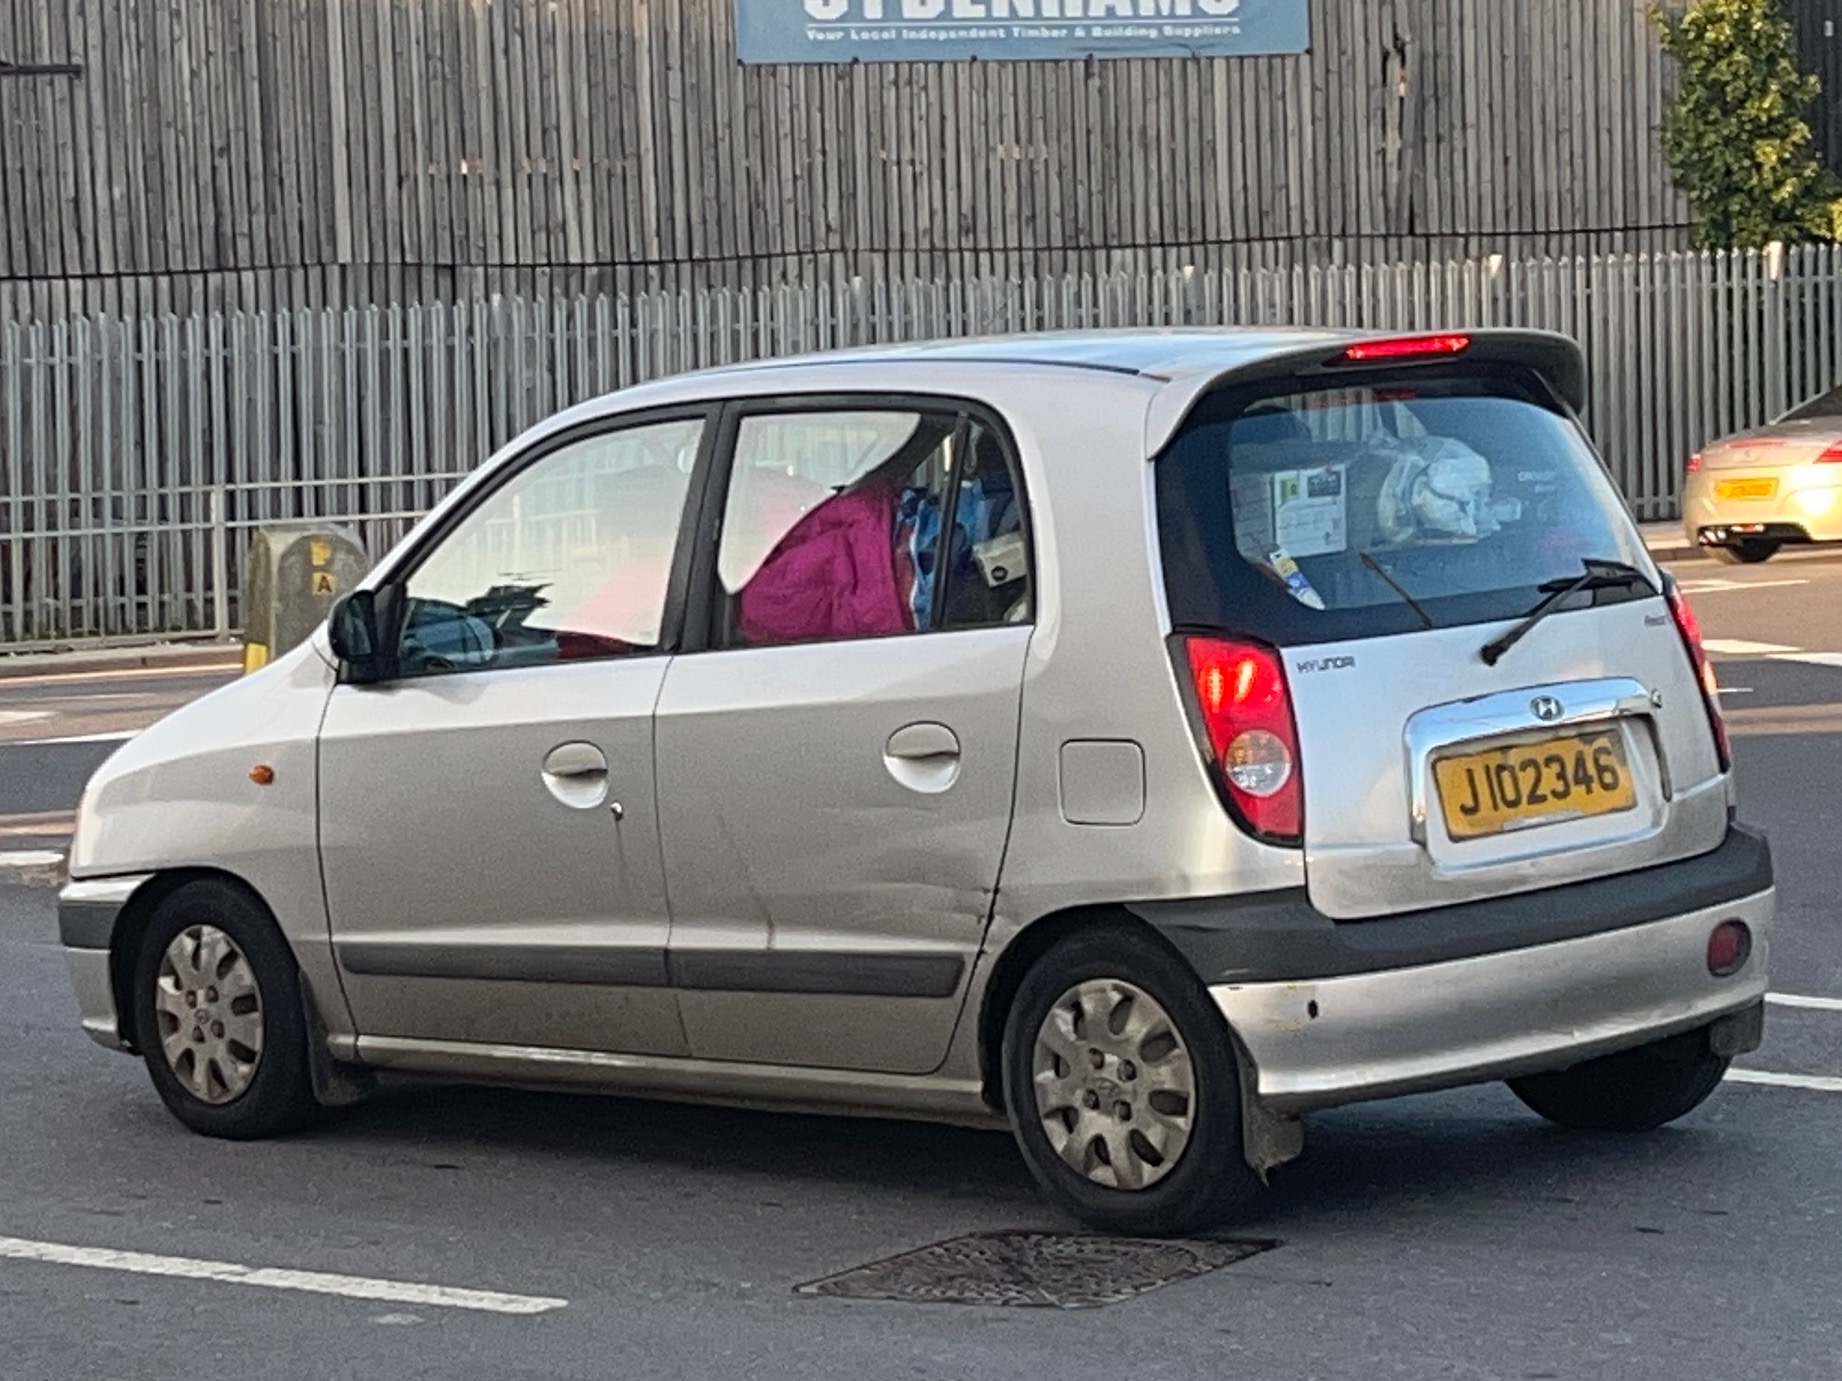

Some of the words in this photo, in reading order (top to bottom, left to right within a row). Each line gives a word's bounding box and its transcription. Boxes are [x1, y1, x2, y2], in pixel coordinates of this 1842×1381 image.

[806, 29, 844, 40] Your
[851, 28, 896, 40] Local
[902, 27, 1006, 41] Independent
[1013, 27, 1068, 38] Timber
[1074, 27, 1086, 37] &
[1092, 26, 1158, 39] Building
[1163, 25, 1241, 38] Suppliers
[1459, 747, 1620, 816] J102346
